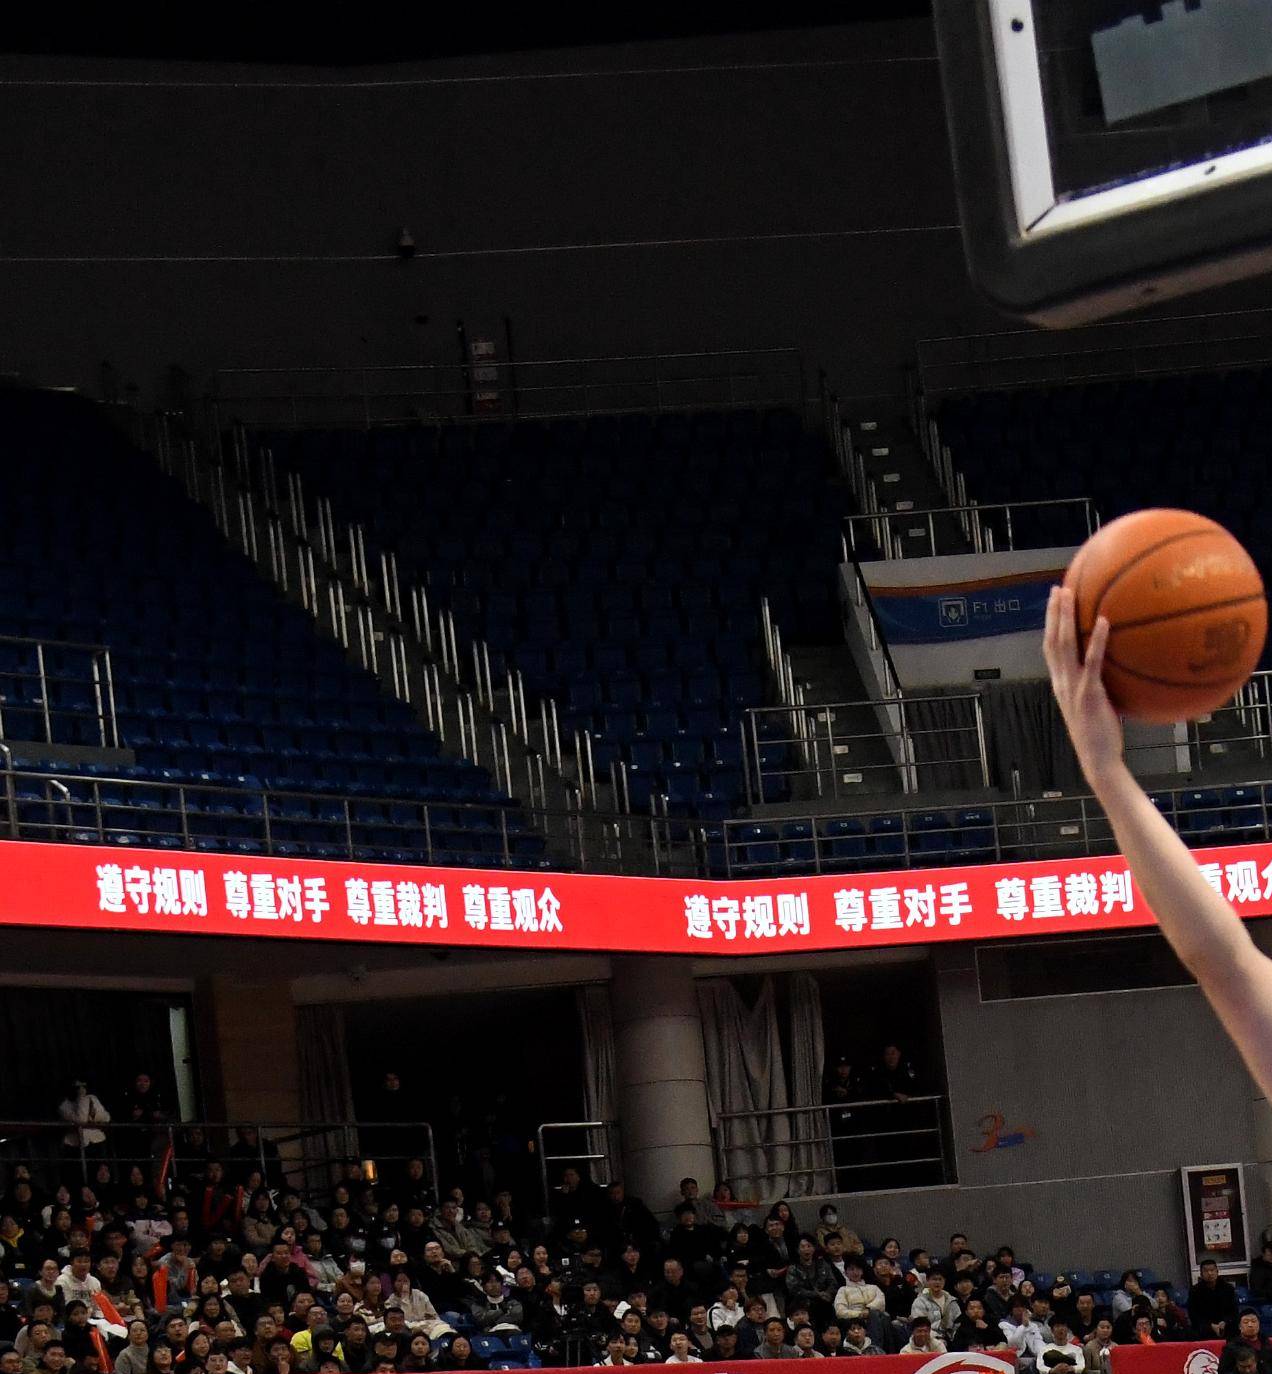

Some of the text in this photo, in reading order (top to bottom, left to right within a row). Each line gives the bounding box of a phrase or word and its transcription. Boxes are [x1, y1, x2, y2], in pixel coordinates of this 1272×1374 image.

[973, 599, 1020, 613] F1 出口
[97, 864, 563, 933] 遵守规则 尊重对手 尊重裁判 尊重观众
[684, 890, 811, 941] 遵守规则
[834, 881, 973, 931] 尊重对手
[994, 870, 1134, 922] 尊重裁判
